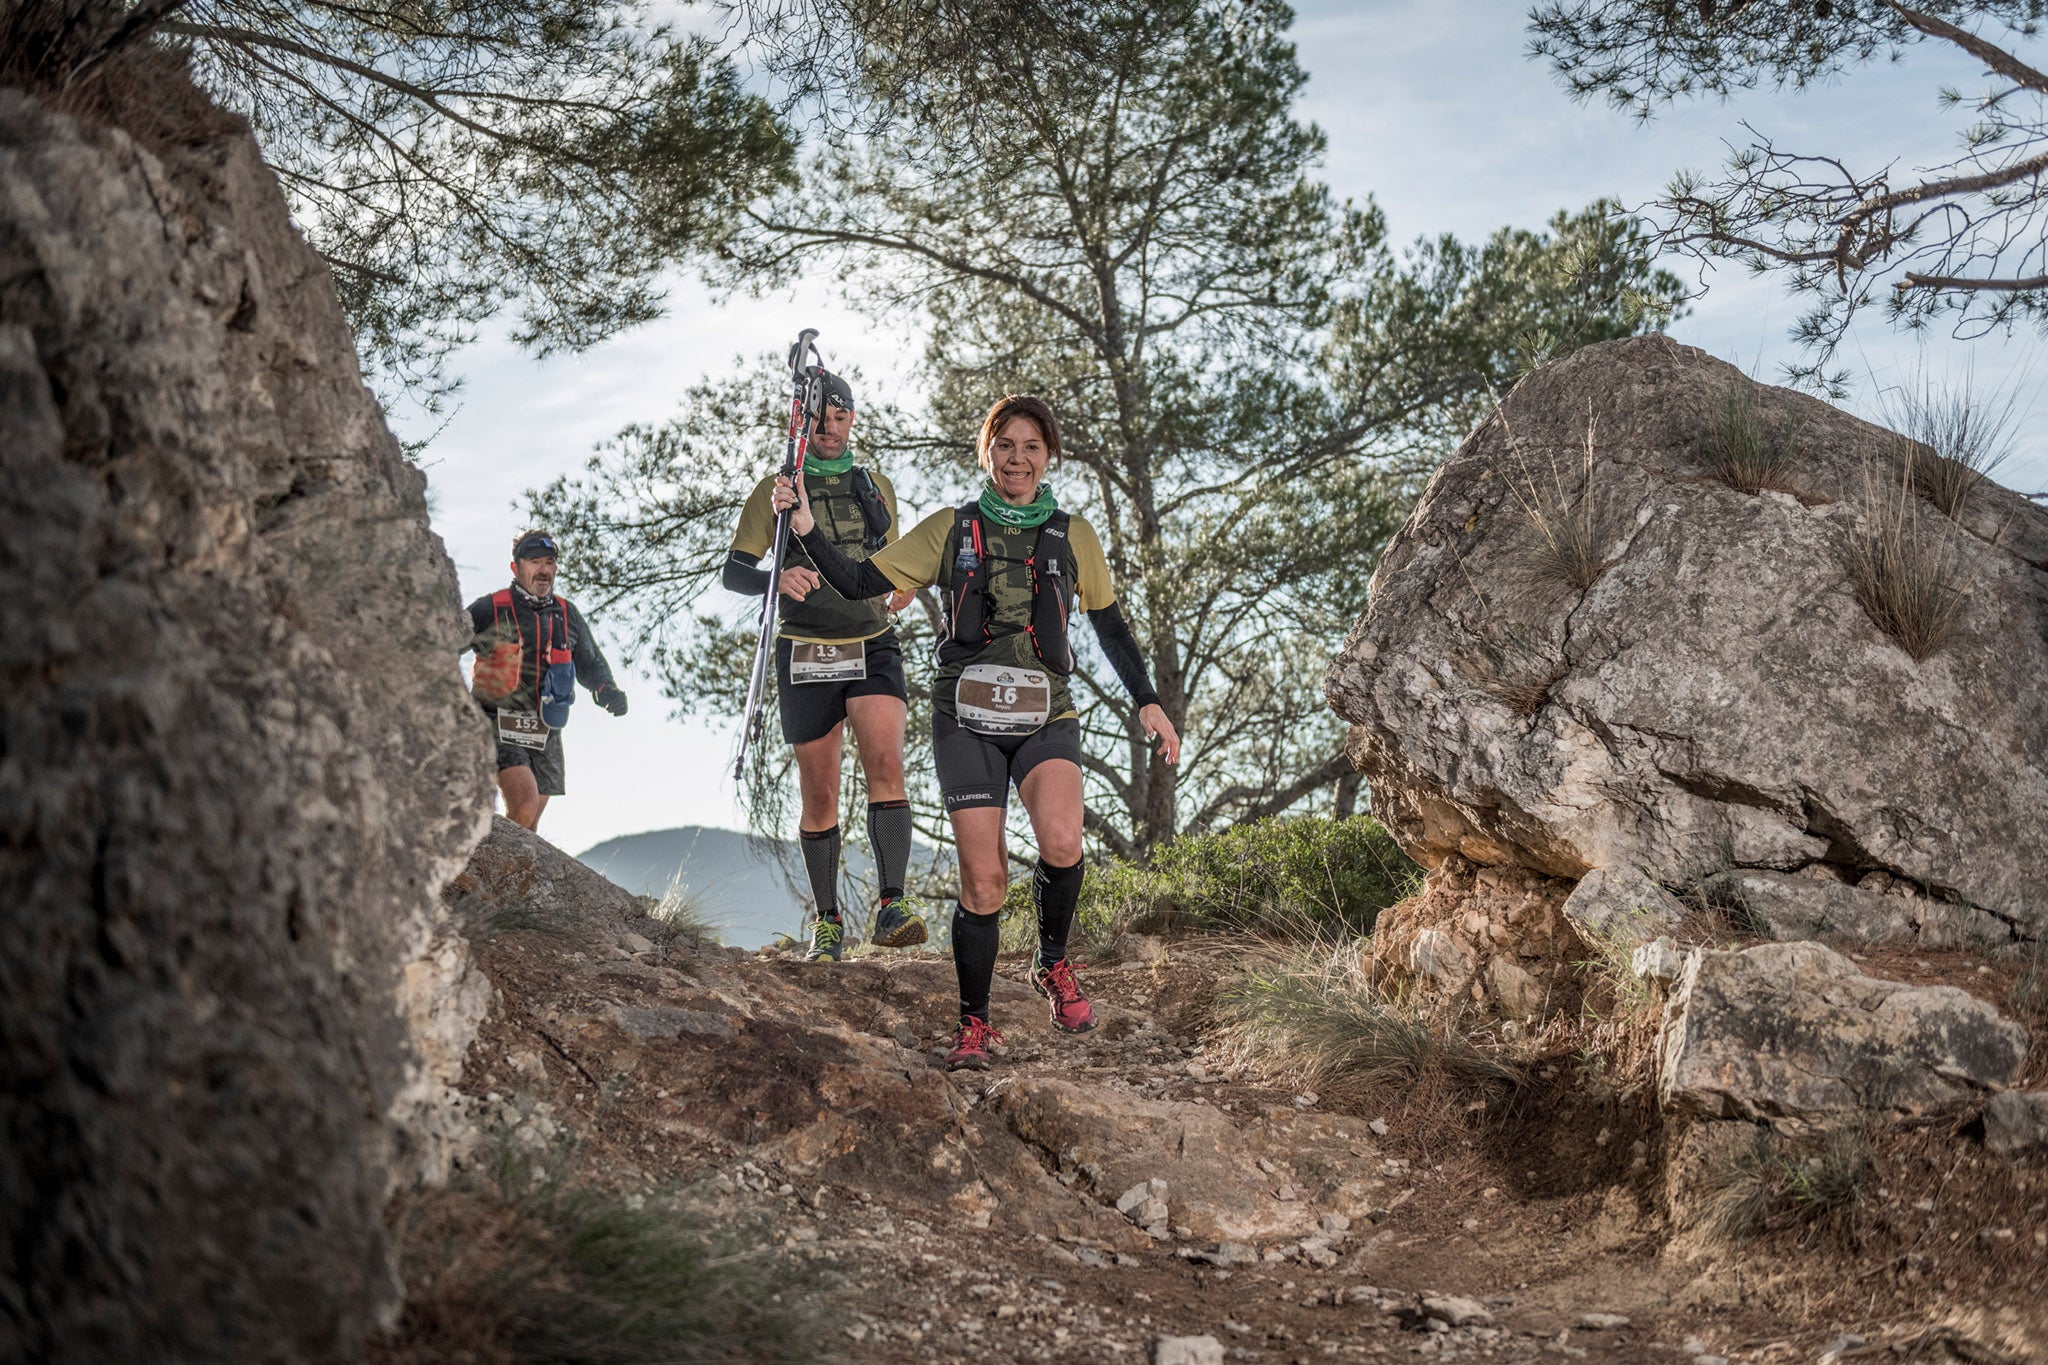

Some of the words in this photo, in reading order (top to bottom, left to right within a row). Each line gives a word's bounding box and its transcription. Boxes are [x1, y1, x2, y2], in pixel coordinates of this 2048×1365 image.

[816, 645, 837, 657] 13
[991, 686, 1018, 704] 16
[515, 718, 539, 730] 152
[956, 793, 993, 802] LURBEL
